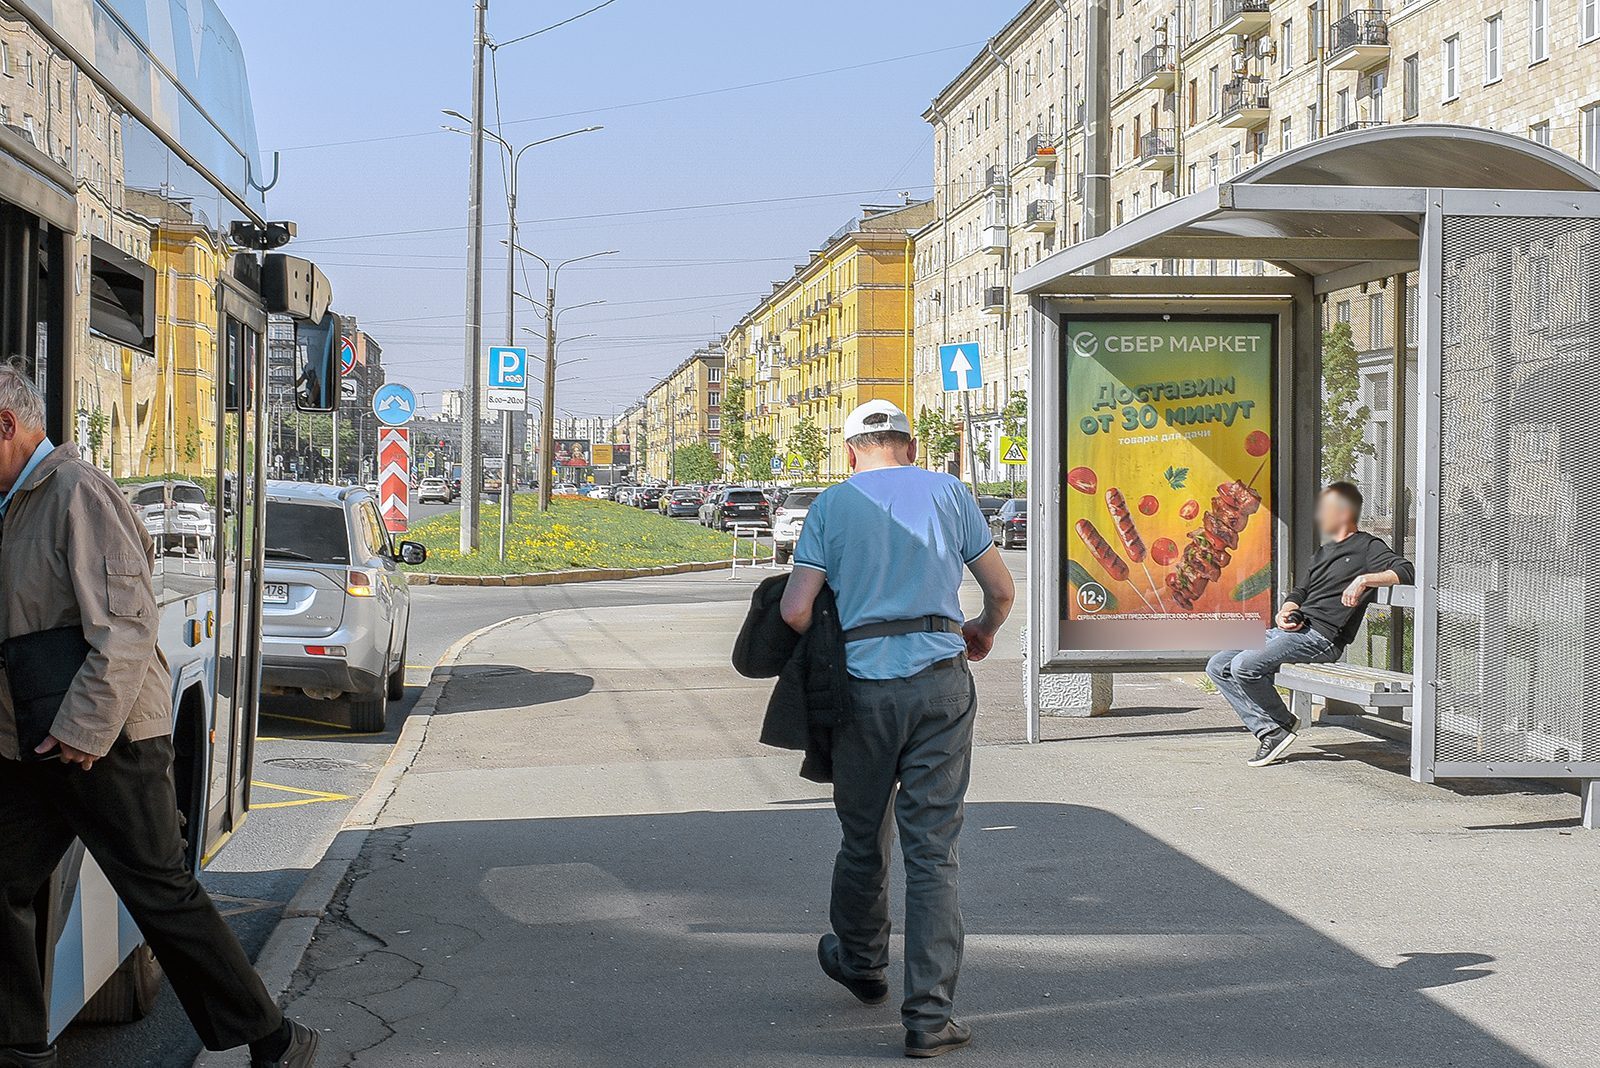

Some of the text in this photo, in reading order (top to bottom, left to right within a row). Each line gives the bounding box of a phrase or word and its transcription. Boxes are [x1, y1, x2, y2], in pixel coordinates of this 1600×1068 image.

[1104, 335, 1261, 353] СБЕР МАРКЕТ
[498, 351, 520, 384] P
[1092, 375, 1236, 411] Доставим
[1079, 399, 1256, 436] от 30 минут
[1118, 429, 1211, 446] товары для дачи
[264, 585, 284, 596] 178
[1081, 590, 1104, 605] 12+
